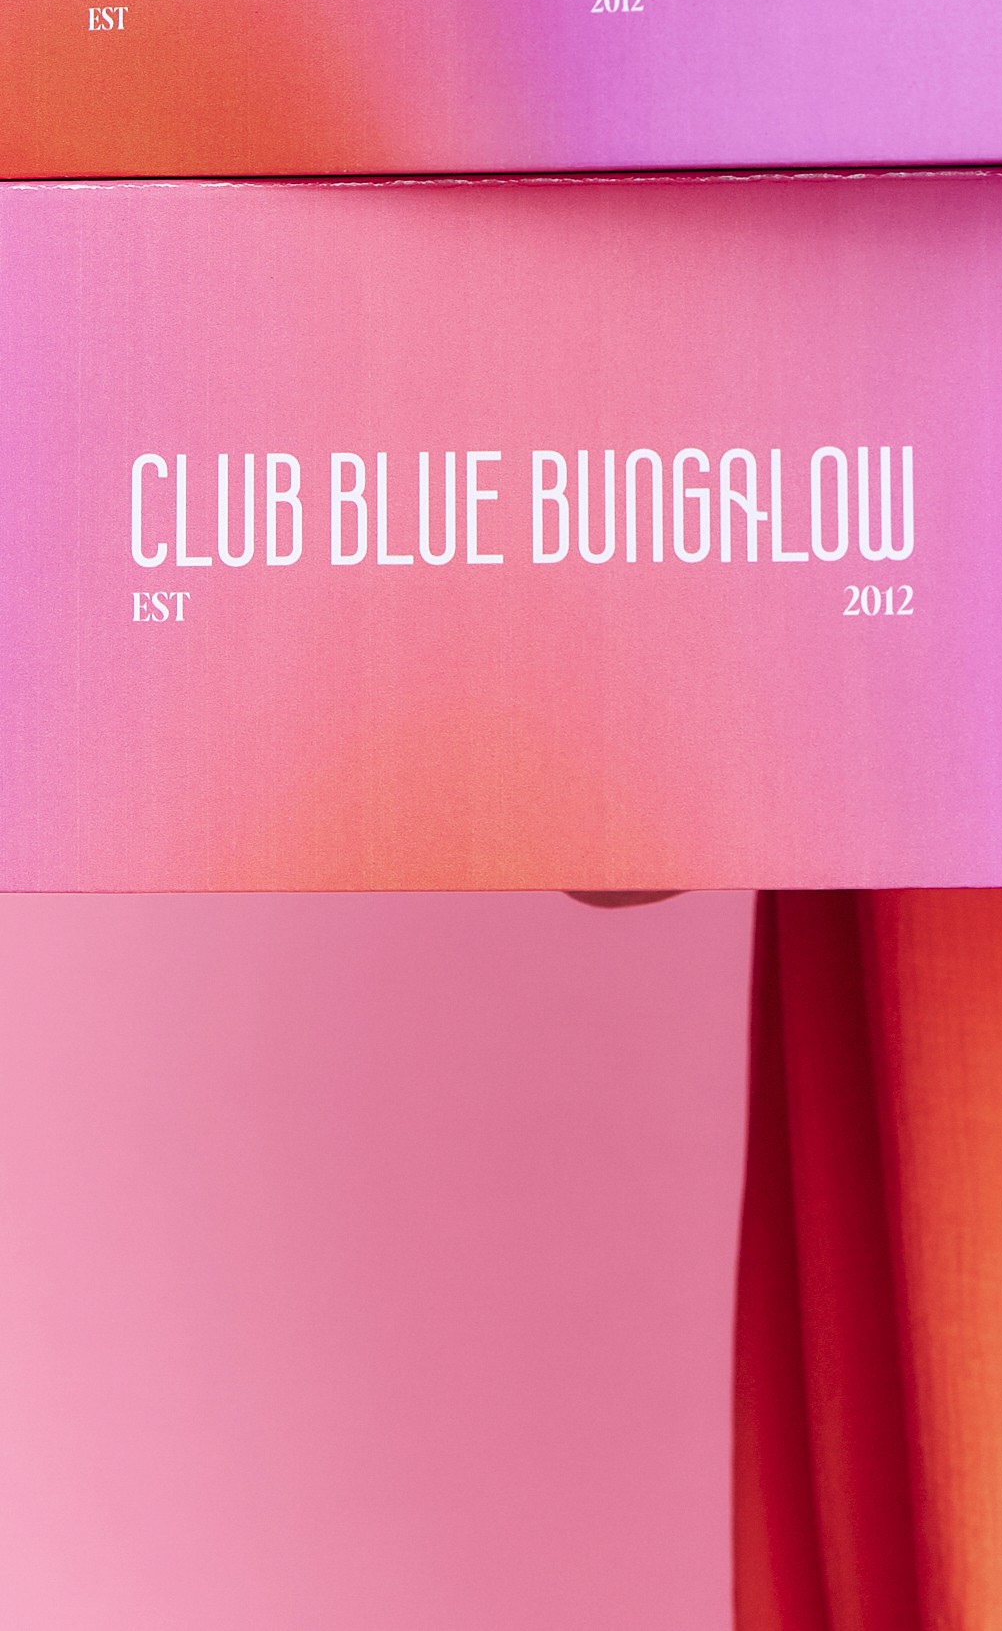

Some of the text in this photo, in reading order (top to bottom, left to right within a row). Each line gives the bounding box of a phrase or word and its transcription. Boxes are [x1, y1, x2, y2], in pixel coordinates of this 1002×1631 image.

[87, 6, 129, 31] EST
[131, 445, 915, 568] CLUB BLUE BUNGALOW
[132, 584, 915, 622] EST 2012
